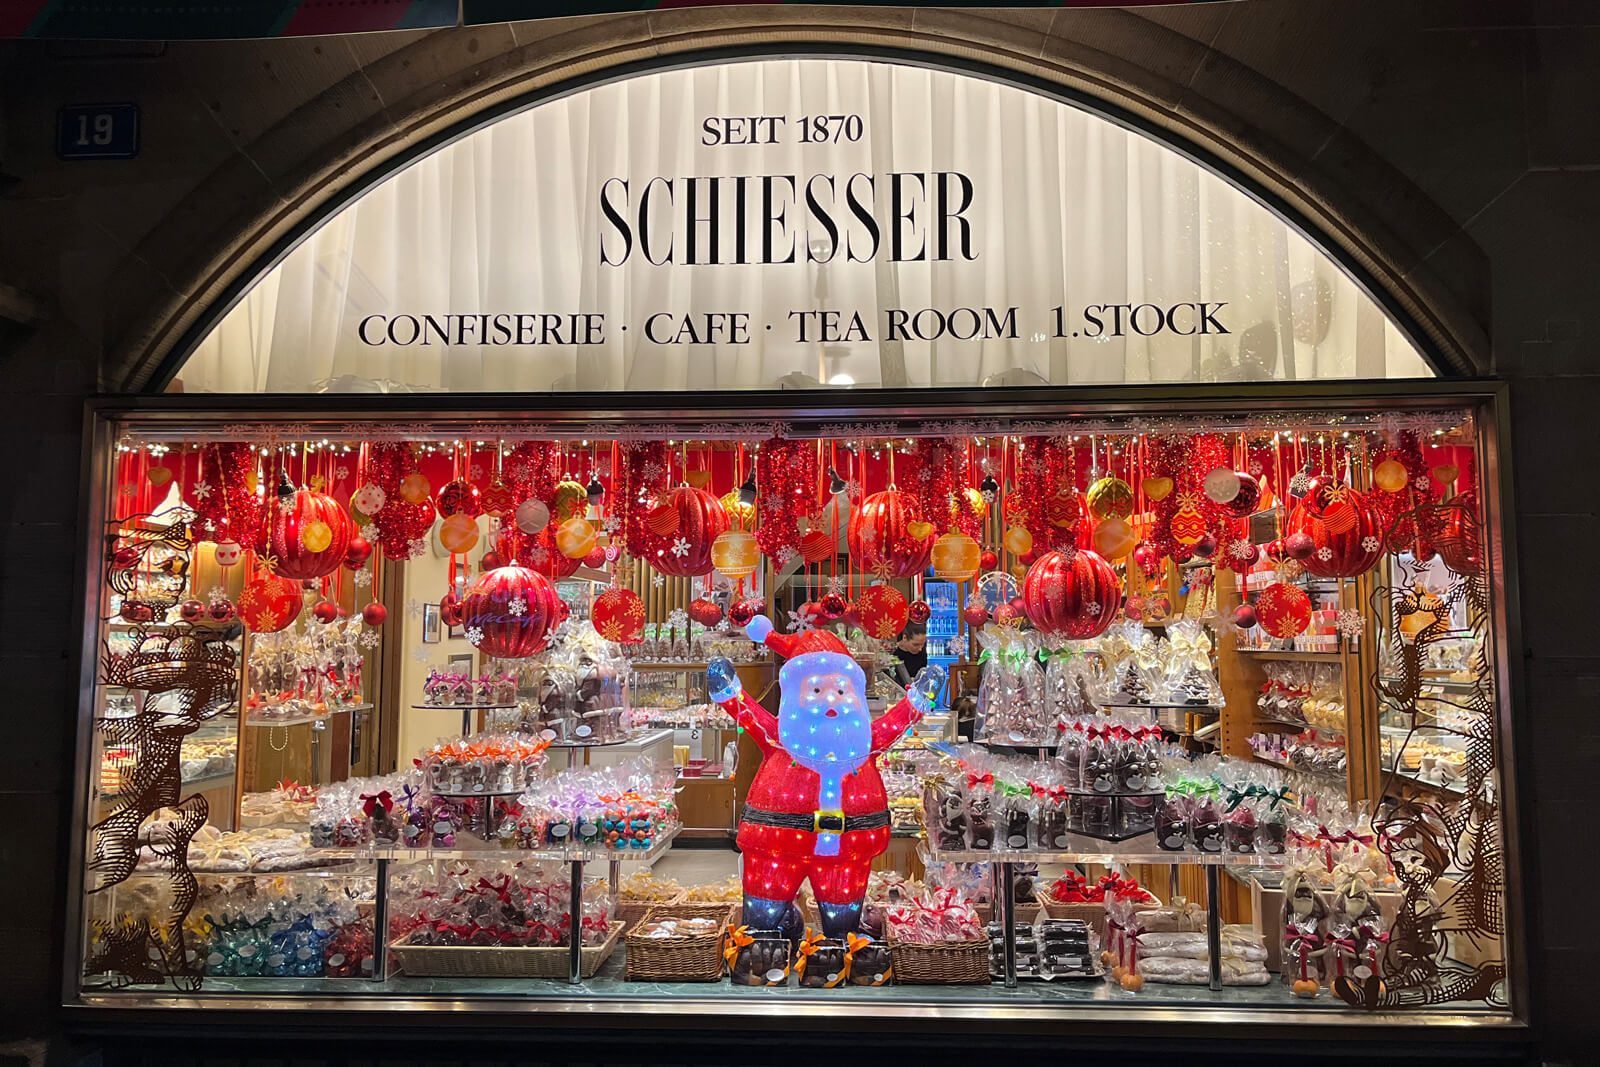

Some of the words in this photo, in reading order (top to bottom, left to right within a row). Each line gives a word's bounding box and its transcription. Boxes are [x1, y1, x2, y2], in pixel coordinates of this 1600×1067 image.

[76, 114, 114, 146] 19
[702, 117, 786, 146] SEIT
[797, 114, 863, 144] 1870
[600, 172, 980, 267] SCHIESSER
[358, 313, 605, 347] CONFISERIE
[644, 312, 751, 346] CAFE
[788, 311, 871, 344] TEA
[884, 307, 1019, 342] ROOM
[1052, 302, 1232, 339] 1.STOCK
